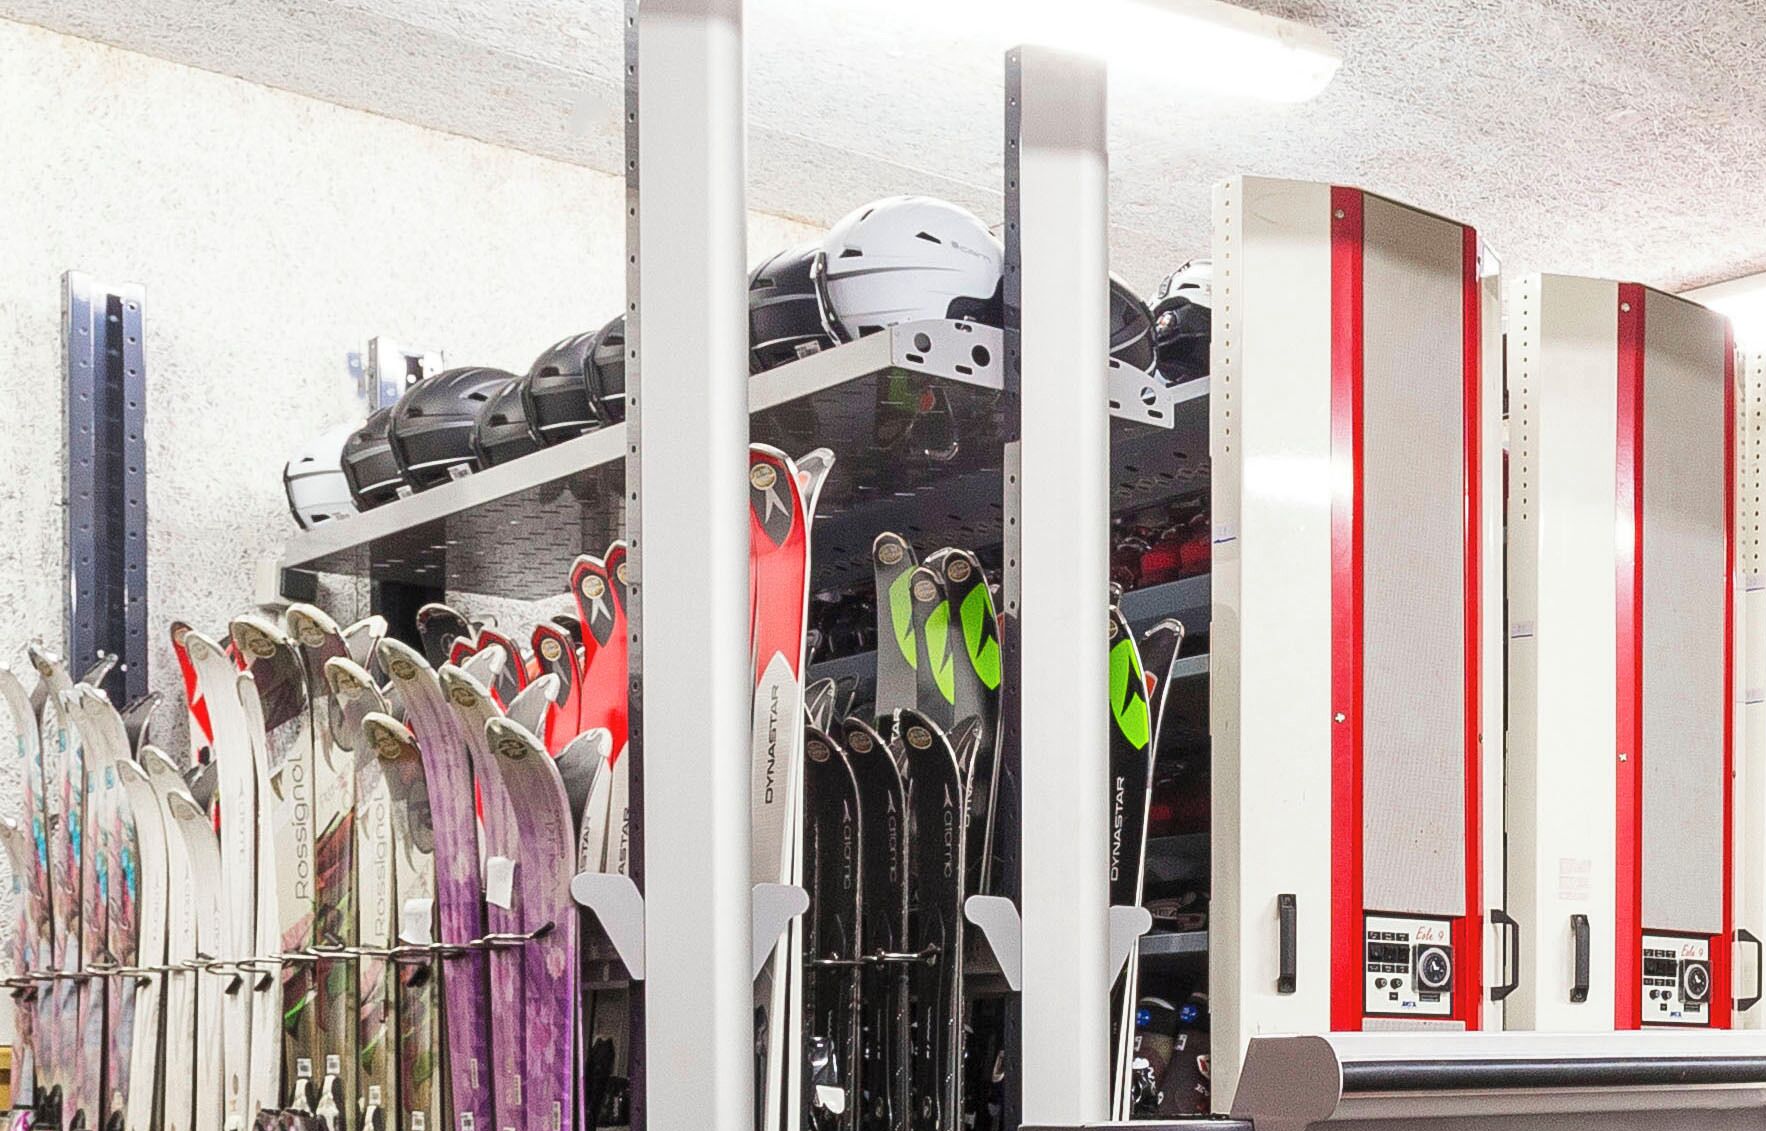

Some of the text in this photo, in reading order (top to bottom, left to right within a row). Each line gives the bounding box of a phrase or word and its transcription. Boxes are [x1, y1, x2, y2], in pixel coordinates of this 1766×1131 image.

[765, 684, 779, 804] DYNASTAR
[287, 756, 310, 900] Rossignol
[374, 797, 388, 937] Rossignol
[1110, 776, 1124, 881] DYNASTAR
